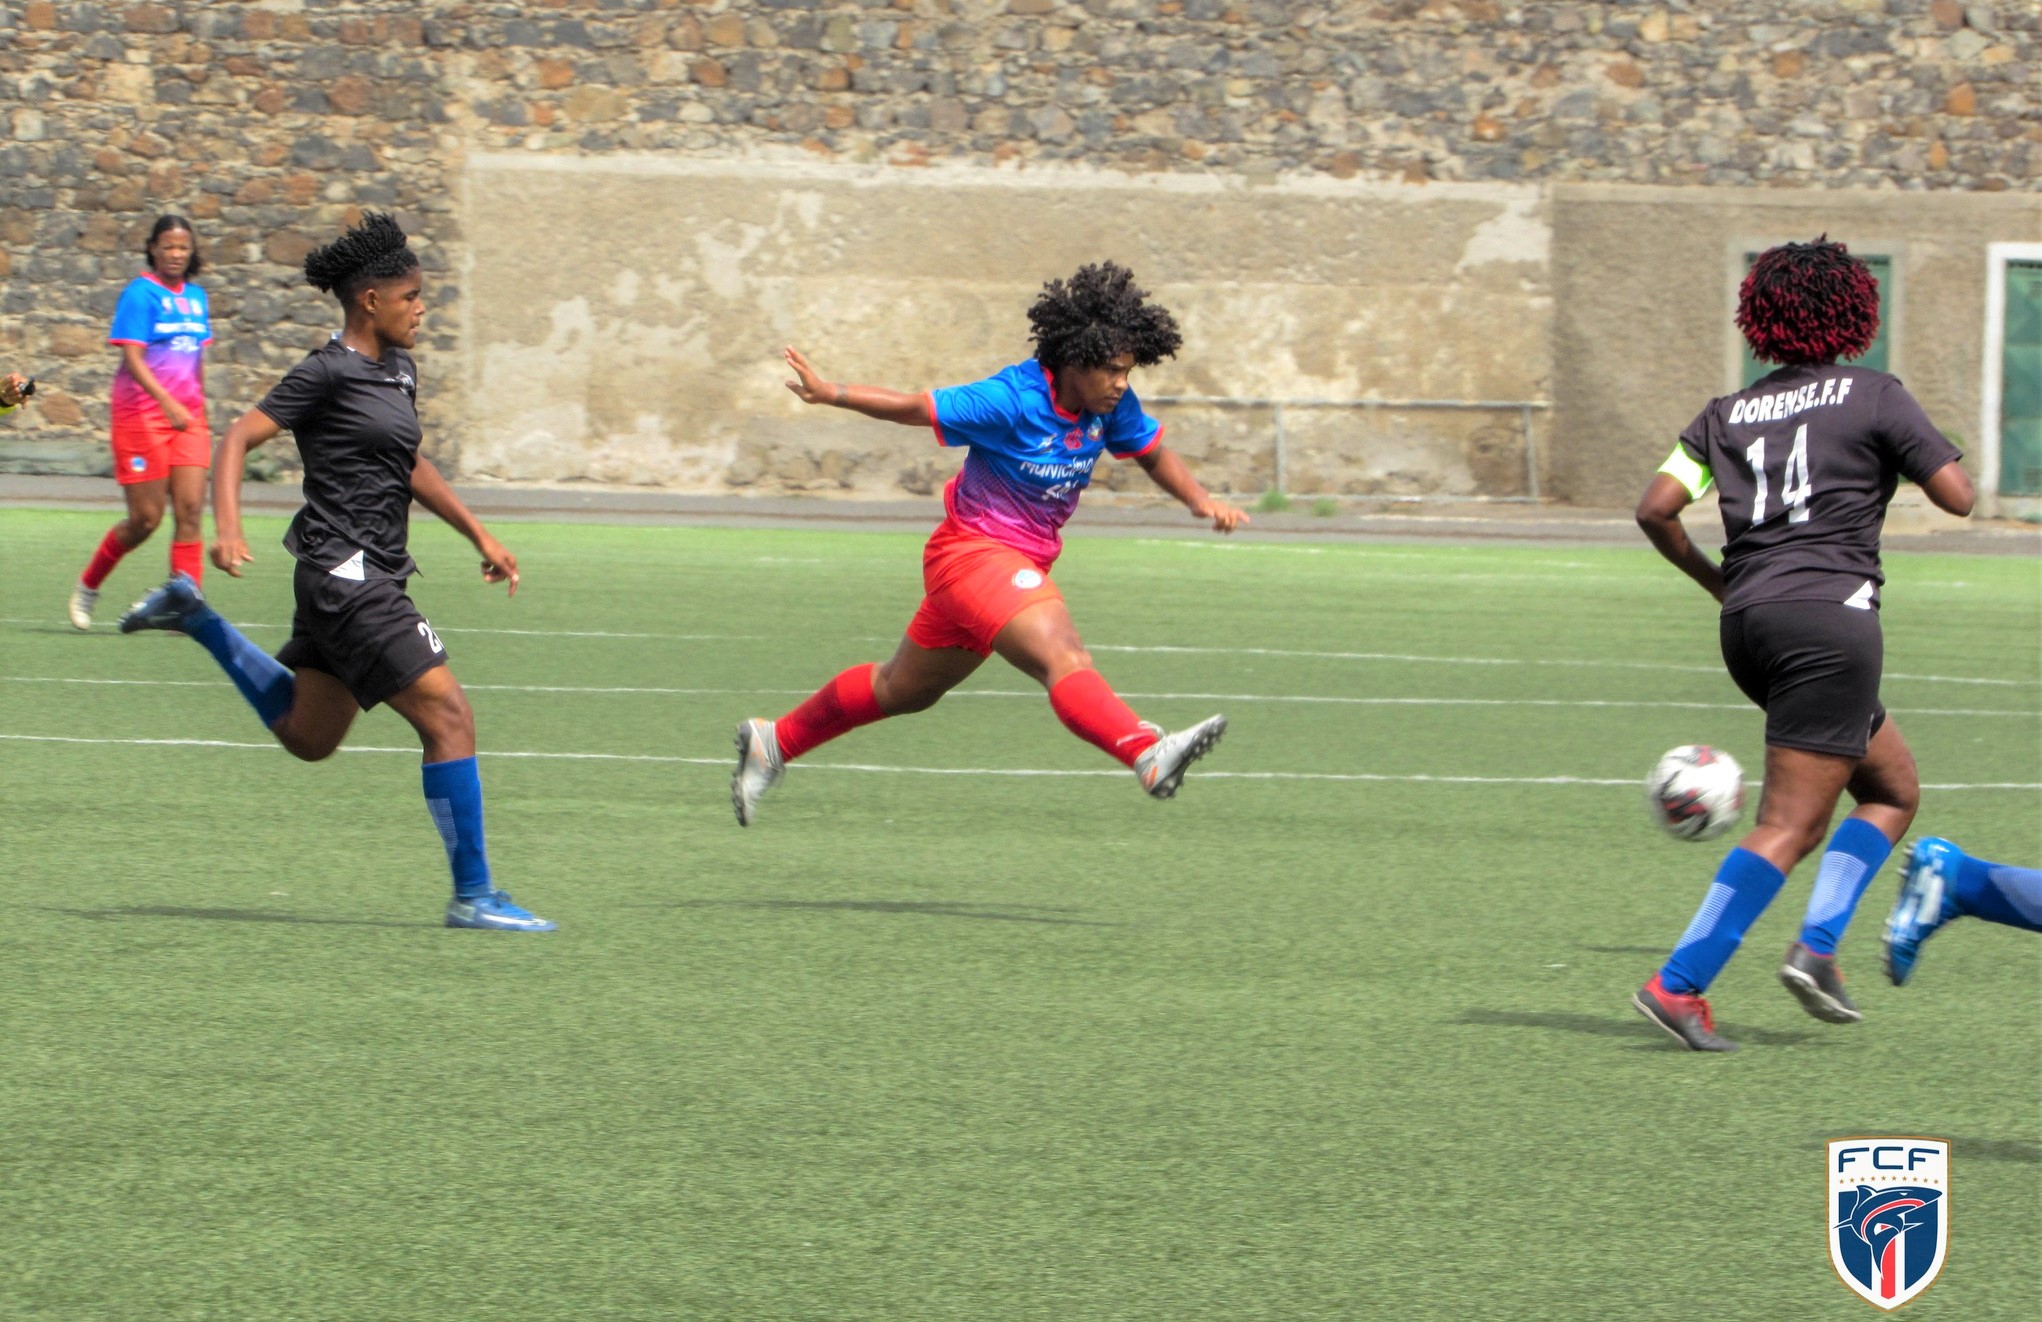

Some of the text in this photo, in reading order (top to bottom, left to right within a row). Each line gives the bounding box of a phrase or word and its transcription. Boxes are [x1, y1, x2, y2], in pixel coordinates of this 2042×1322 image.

[1728, 378, 1853, 424] DORENSE.F.F
[1746, 423, 1812, 526] 14
[417, 618, 445, 654] 2
